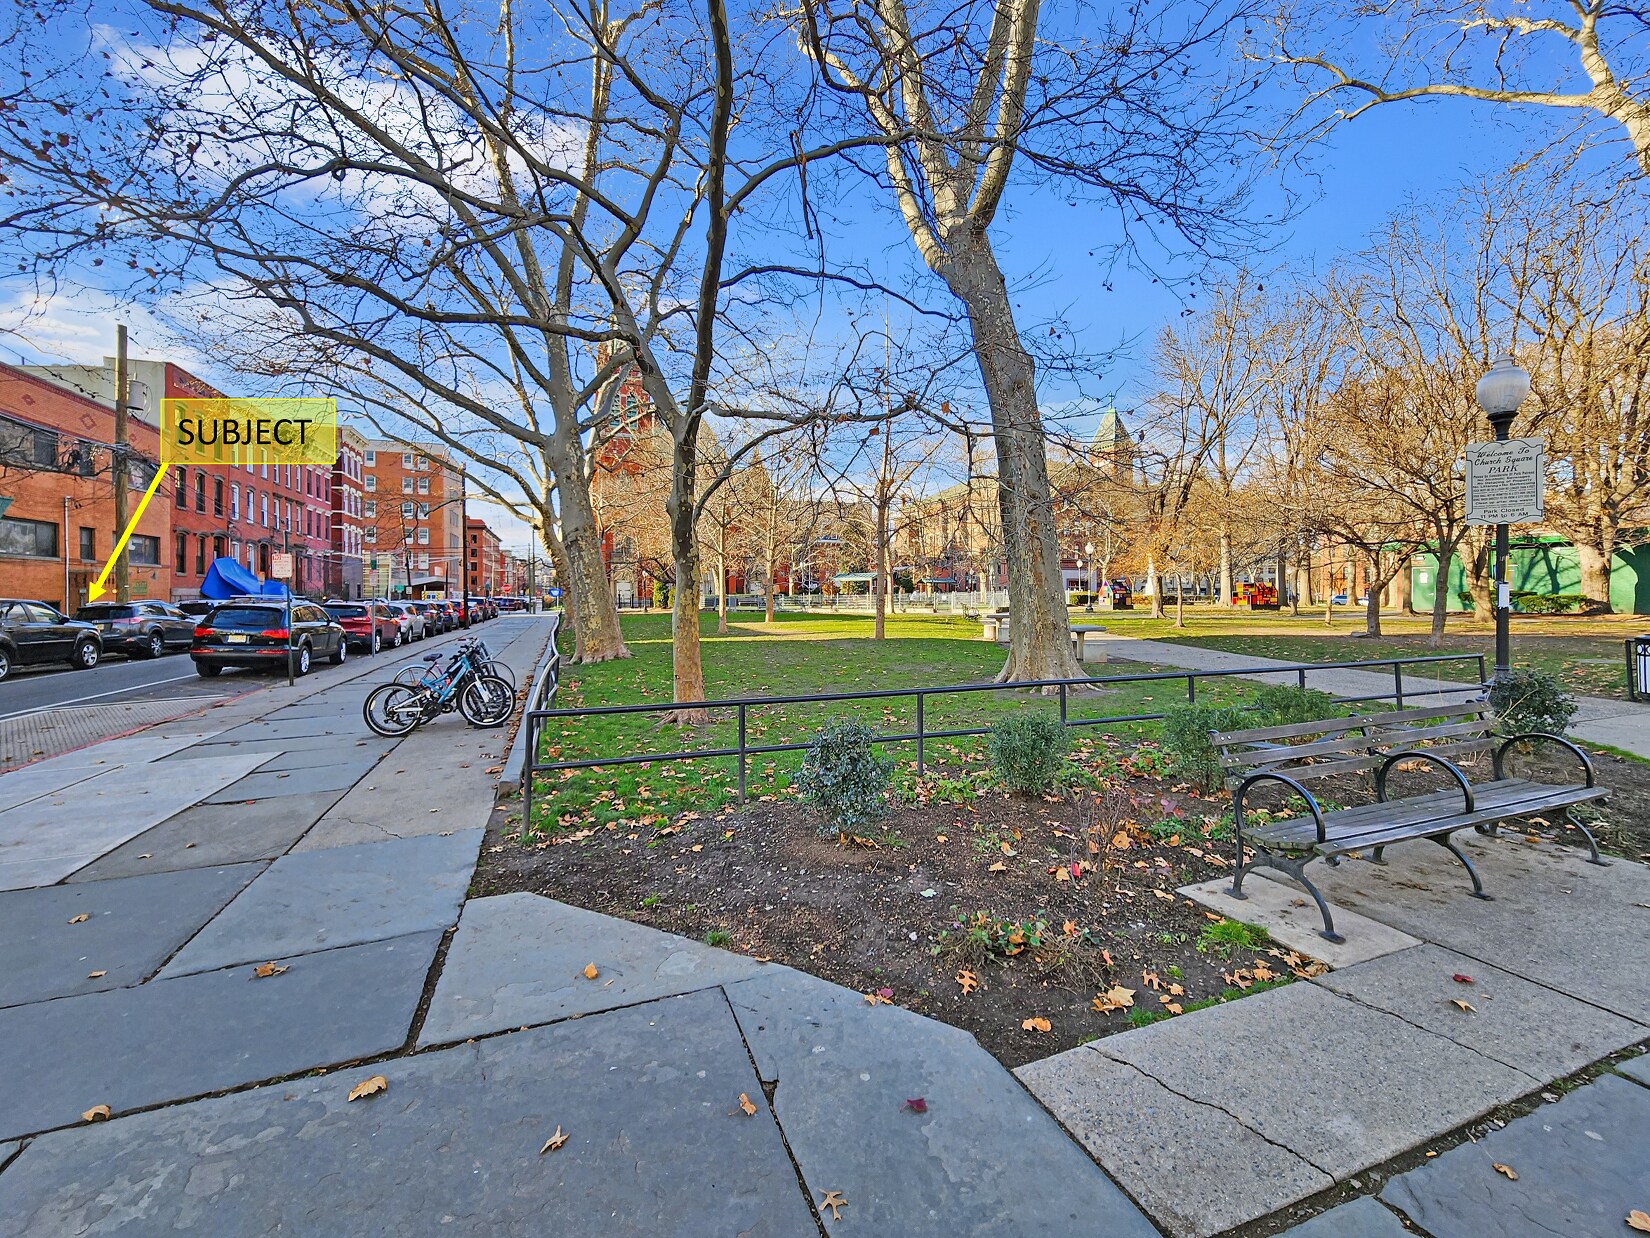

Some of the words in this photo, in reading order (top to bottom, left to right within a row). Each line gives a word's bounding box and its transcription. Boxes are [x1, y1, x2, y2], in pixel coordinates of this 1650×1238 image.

[1477, 450, 1513, 458] Welcome
[1474, 457, 1502, 466] Church
[1504, 456, 1533, 465] Square
[1488, 464, 1518, 474] PARK
